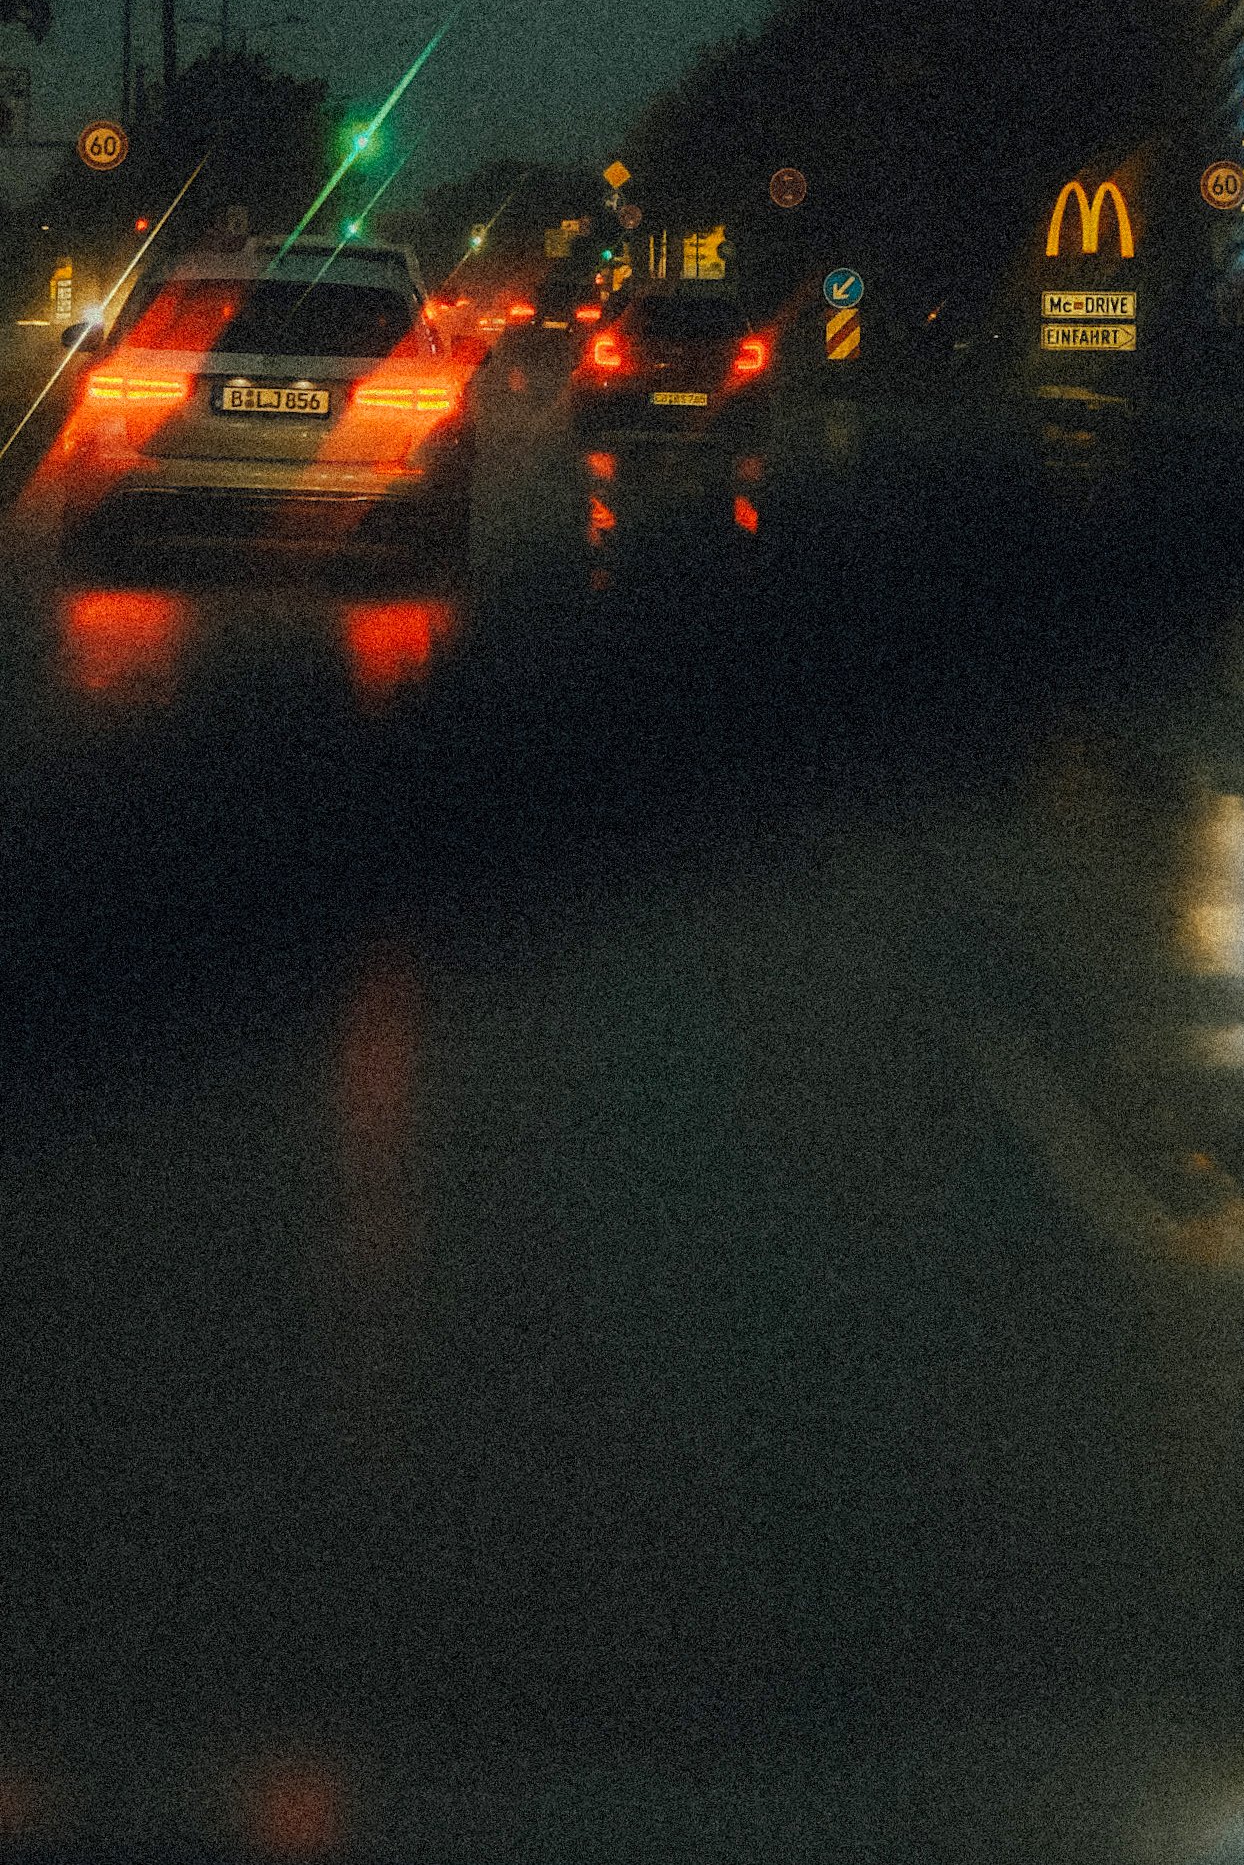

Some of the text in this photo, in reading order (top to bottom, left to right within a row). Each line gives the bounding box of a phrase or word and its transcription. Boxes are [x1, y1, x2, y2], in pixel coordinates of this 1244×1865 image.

[90, 136, 117, 156] 60
[1212, 175, 1238, 196] 60
[1047, 329, 1120, 346] EINFAHRT
